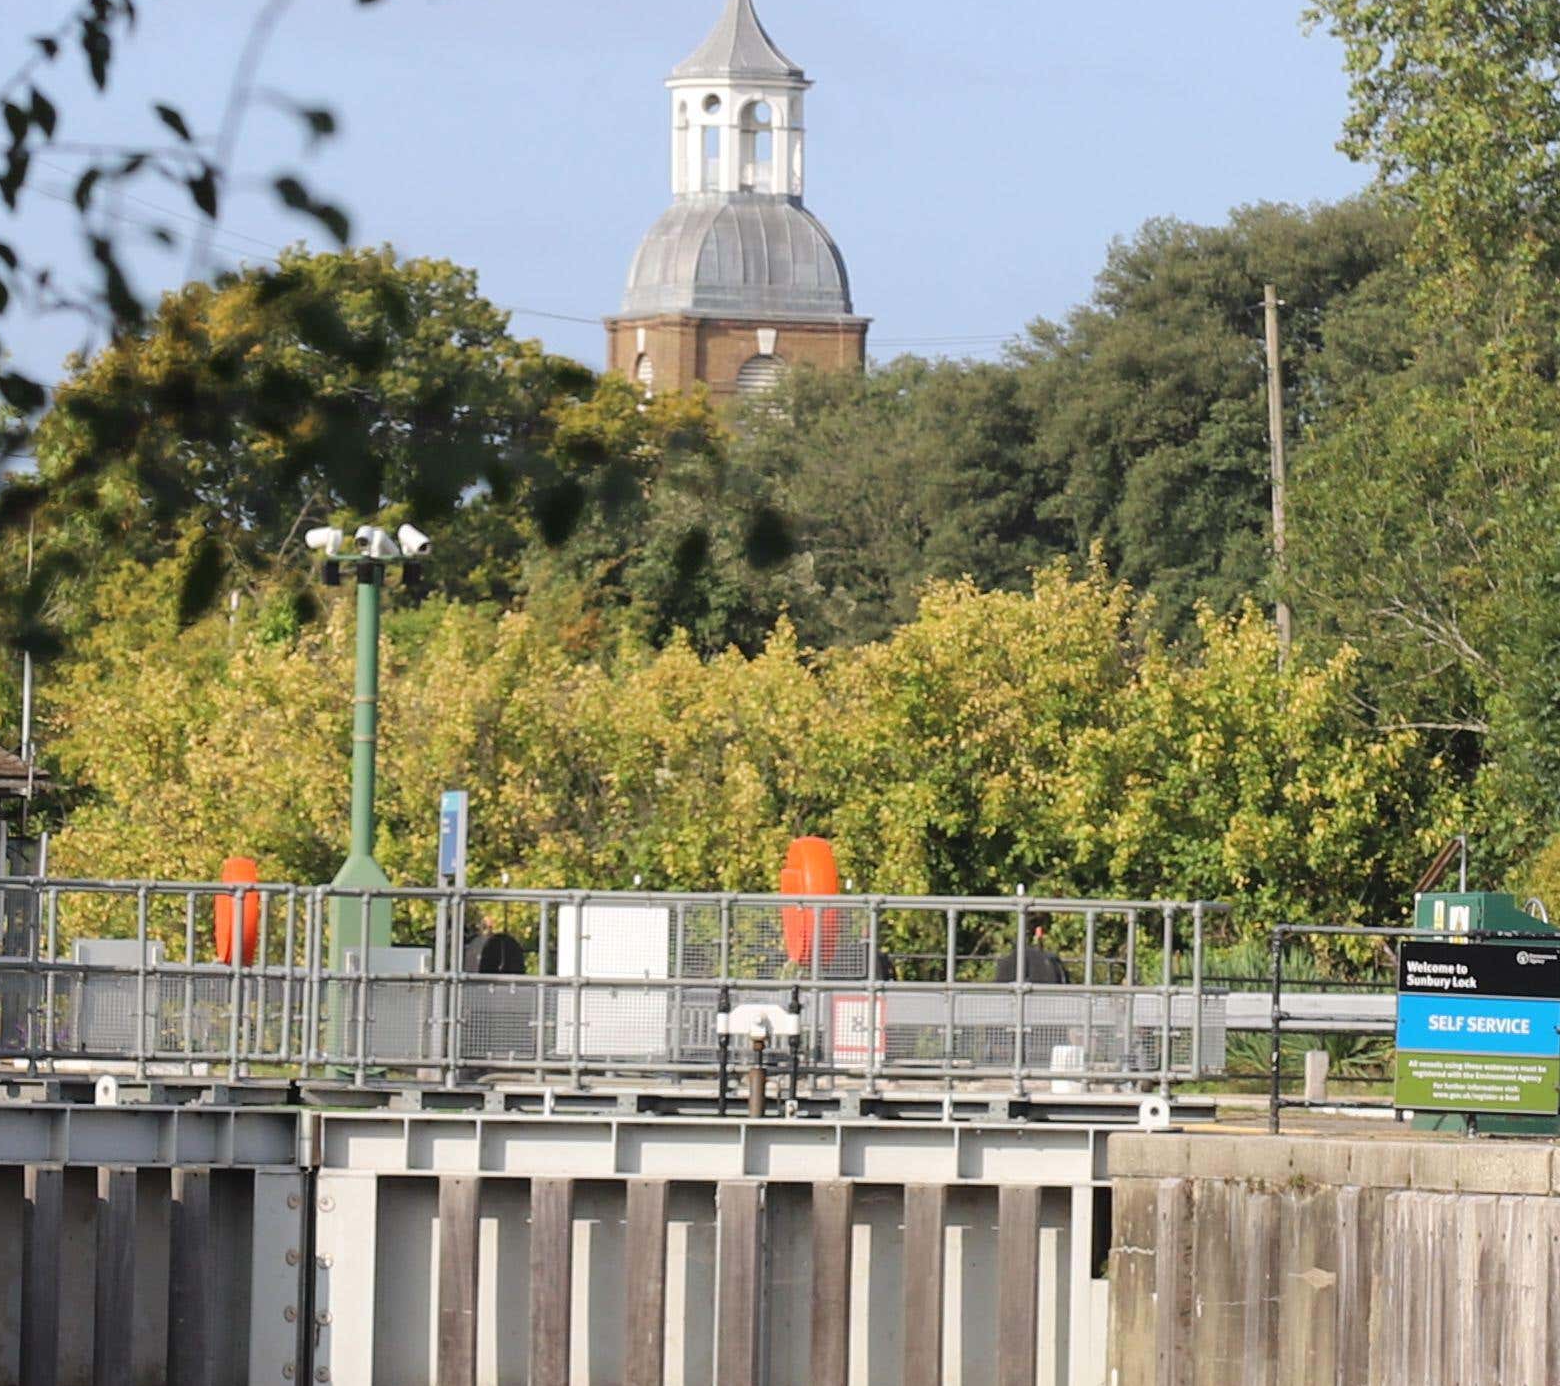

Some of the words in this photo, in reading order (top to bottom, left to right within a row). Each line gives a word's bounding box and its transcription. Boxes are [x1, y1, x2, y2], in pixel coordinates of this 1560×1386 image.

[1406, 960, 1454, 974] Welcome
[1455, 963, 1468, 975] to
[1406, 973, 1451, 990] Sunbury
[1452, 975, 1478, 988] Lock
[1428, 1014, 1465, 1031] SELF
[1466, 1016, 1531, 1034] SERVICE
